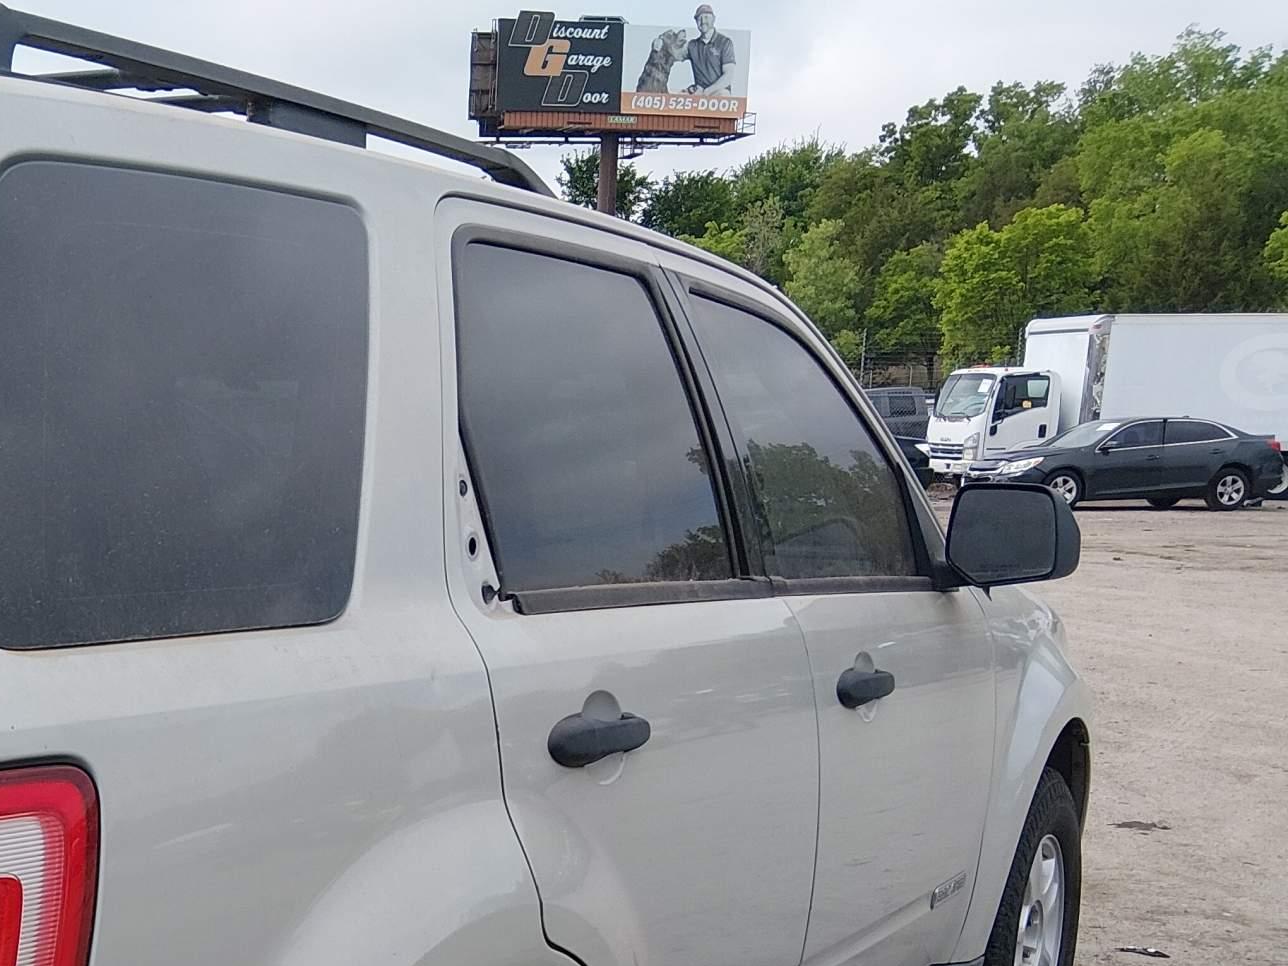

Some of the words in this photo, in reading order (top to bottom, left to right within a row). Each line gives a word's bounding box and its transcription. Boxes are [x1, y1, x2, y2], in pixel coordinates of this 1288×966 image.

[508, 10, 610, 47] Discount
[524, 39, 612, 77] Garage
[541, 70, 609, 107] Door
[631, 95, 666, 111] (405)
[668, 97, 739, 113] 525-DOOR
